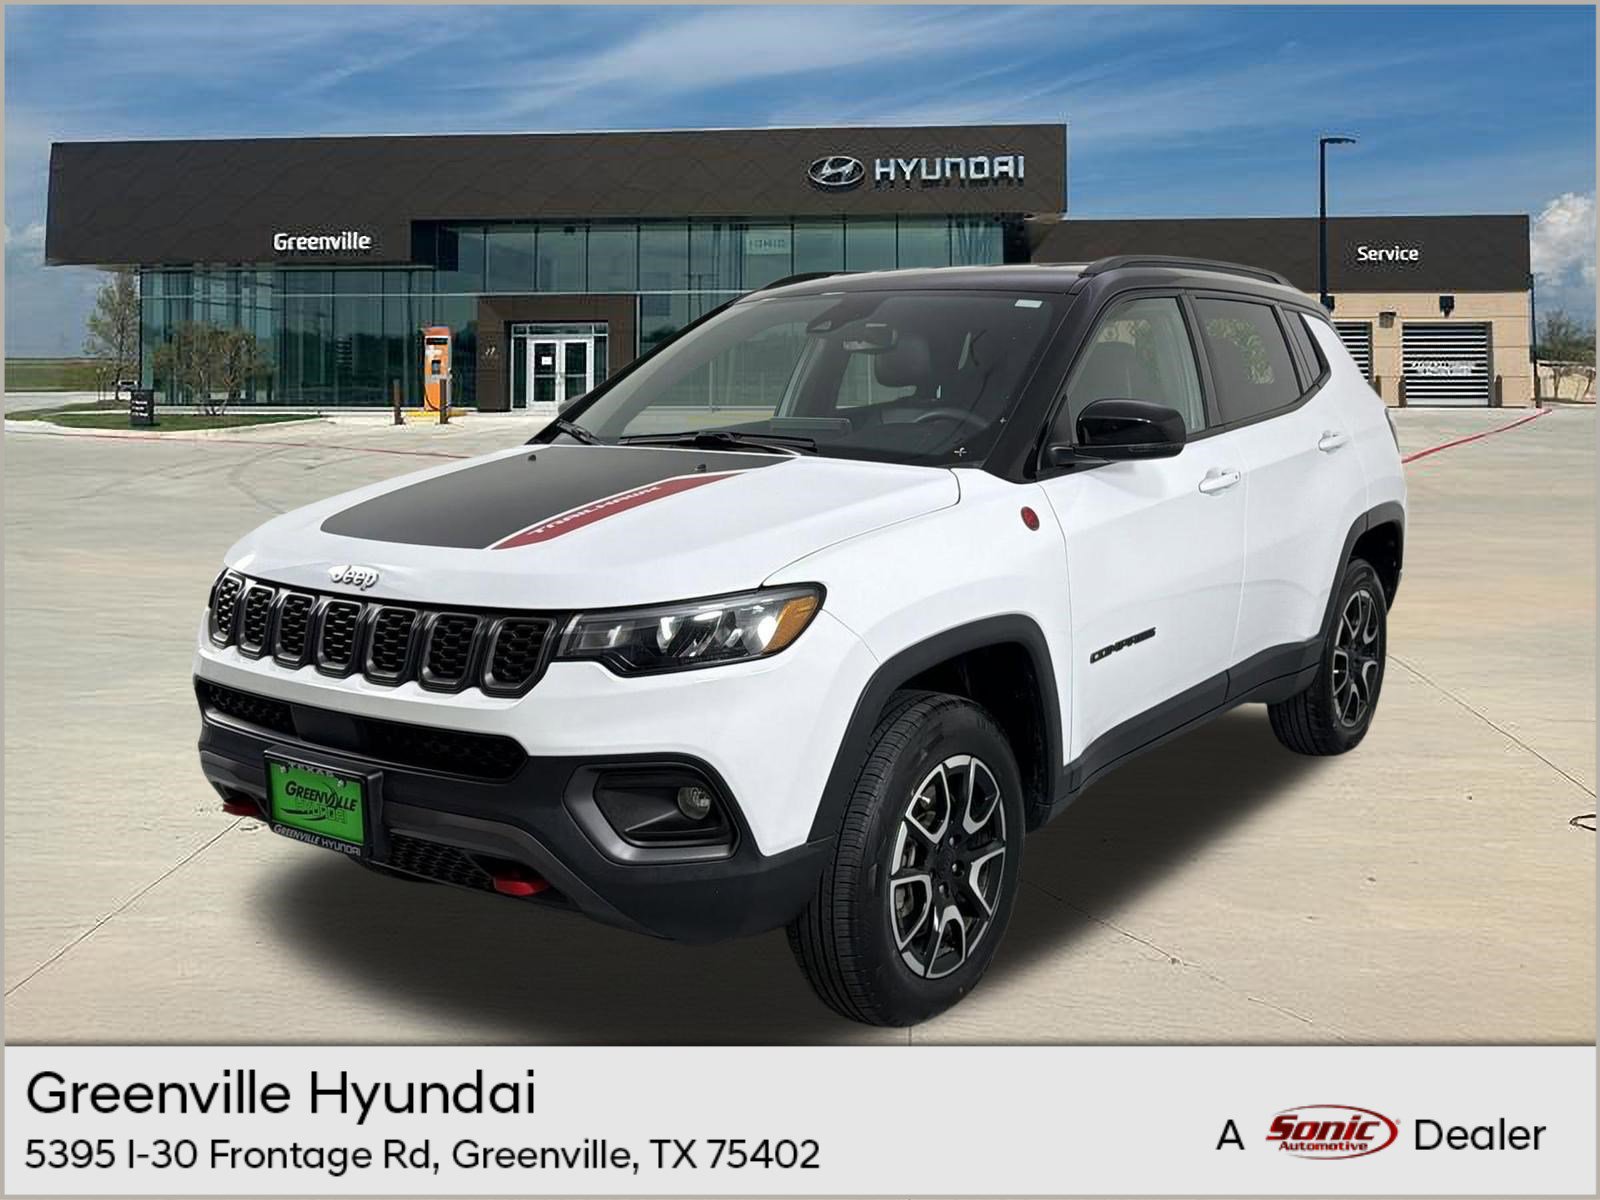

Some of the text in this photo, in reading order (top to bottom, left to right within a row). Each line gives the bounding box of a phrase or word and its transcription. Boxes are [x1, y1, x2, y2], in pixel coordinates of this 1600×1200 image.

[875, 155, 1024, 181] HYUNDAI
[273, 231, 372, 251] Greenville
[1357, 245, 1419, 261] Service
[330, 564, 380, 592] Jeep
[285, 780, 358, 812] GREENVILLE
[273, 824, 361, 857] GREENVILLE HYUNDAI
